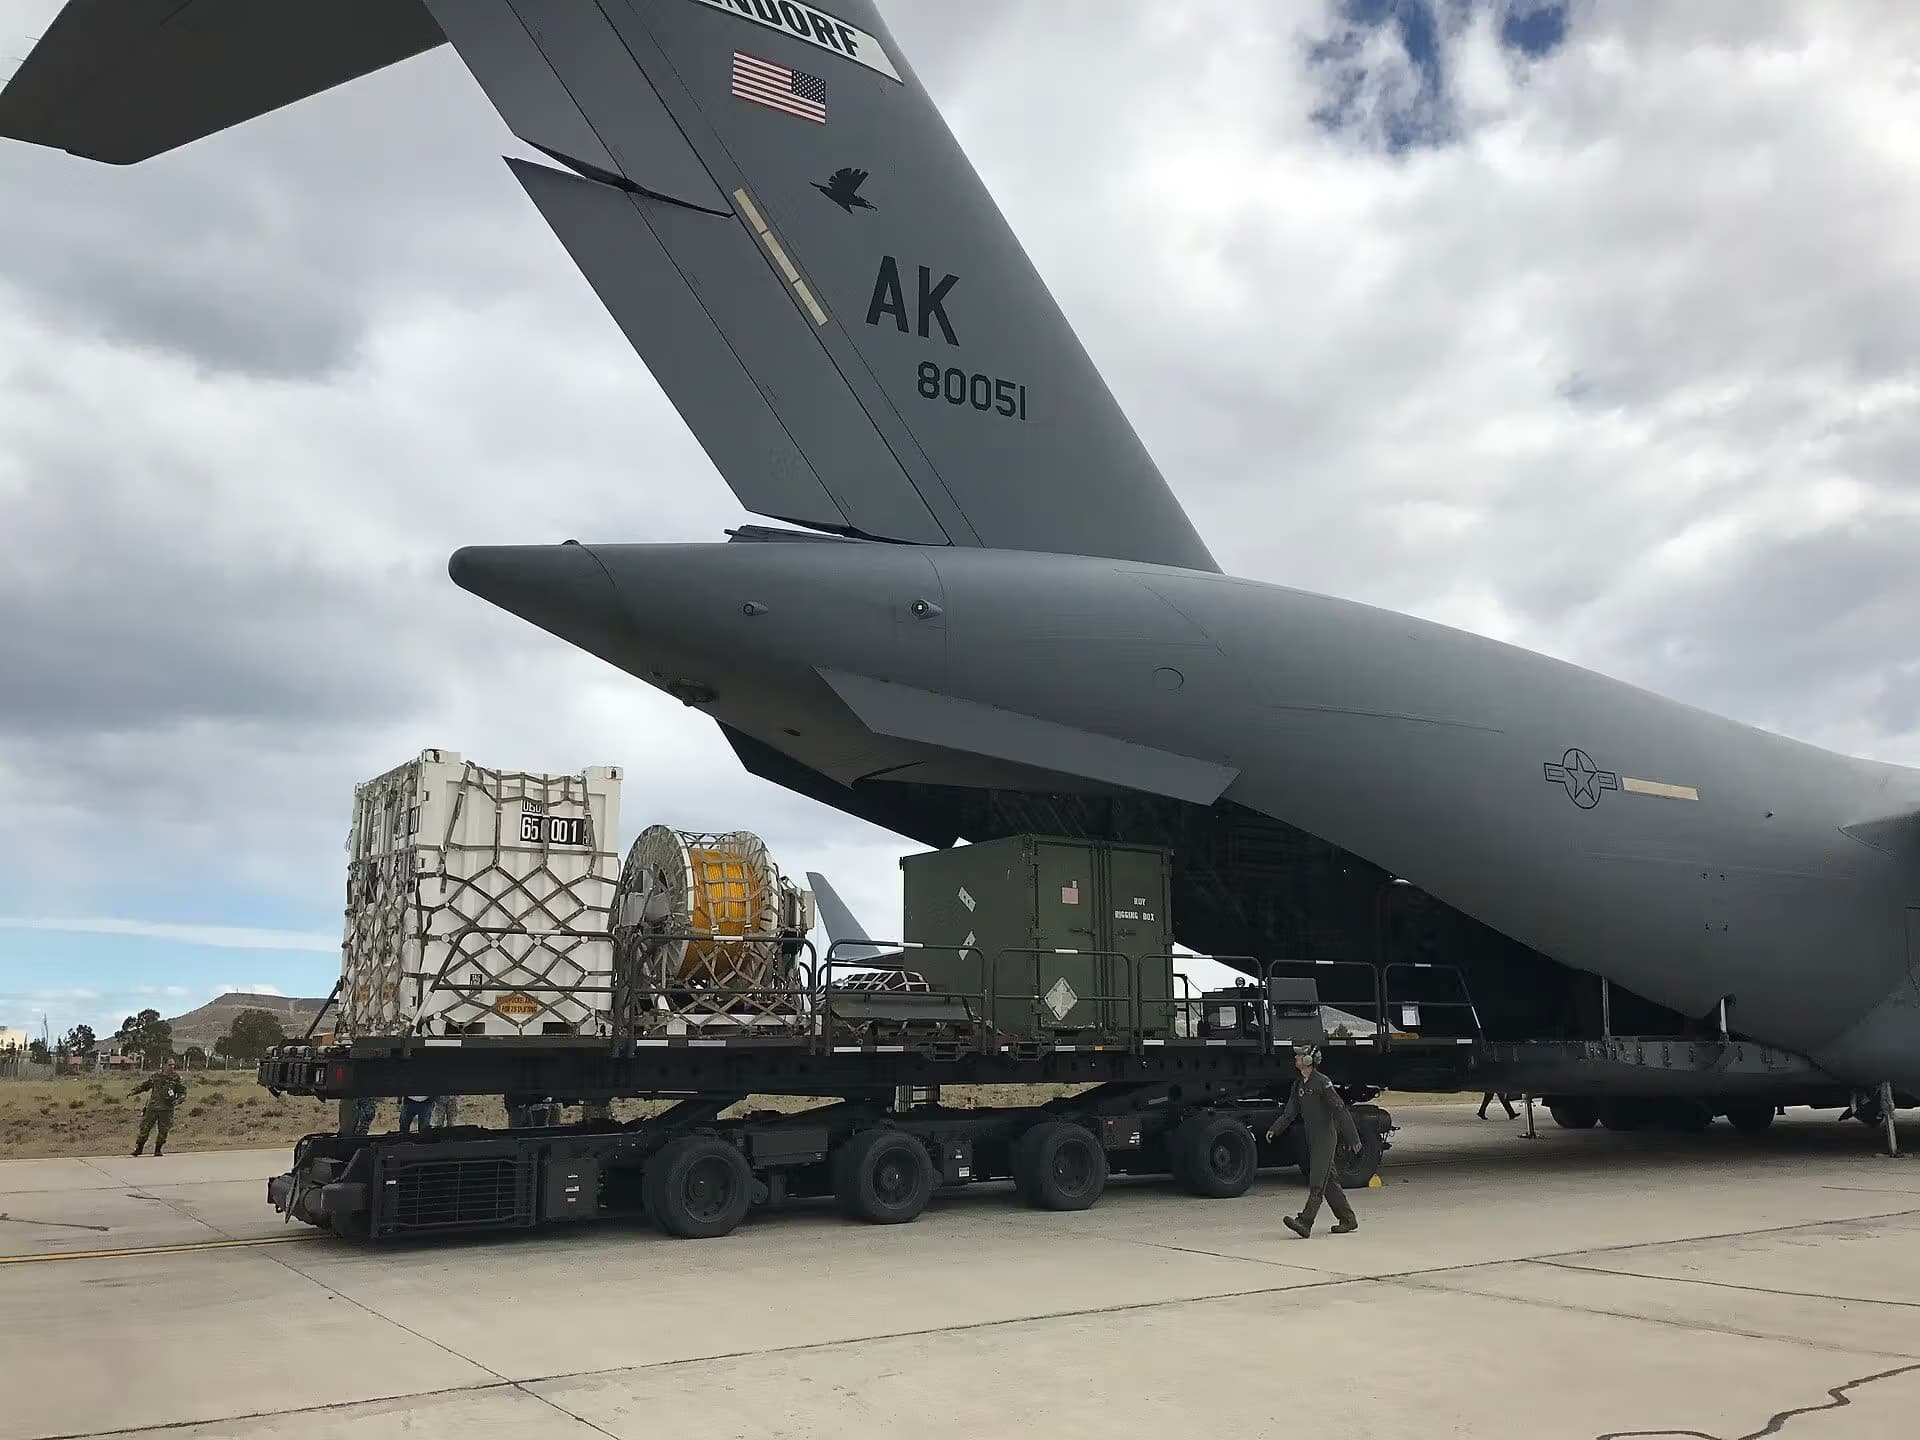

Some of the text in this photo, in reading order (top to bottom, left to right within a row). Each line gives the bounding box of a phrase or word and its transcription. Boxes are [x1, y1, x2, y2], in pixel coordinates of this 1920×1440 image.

[865, 255, 961, 347] AK
[917, 360, 1027, 421] 80051
[1142, 912, 1155, 922] BOX
